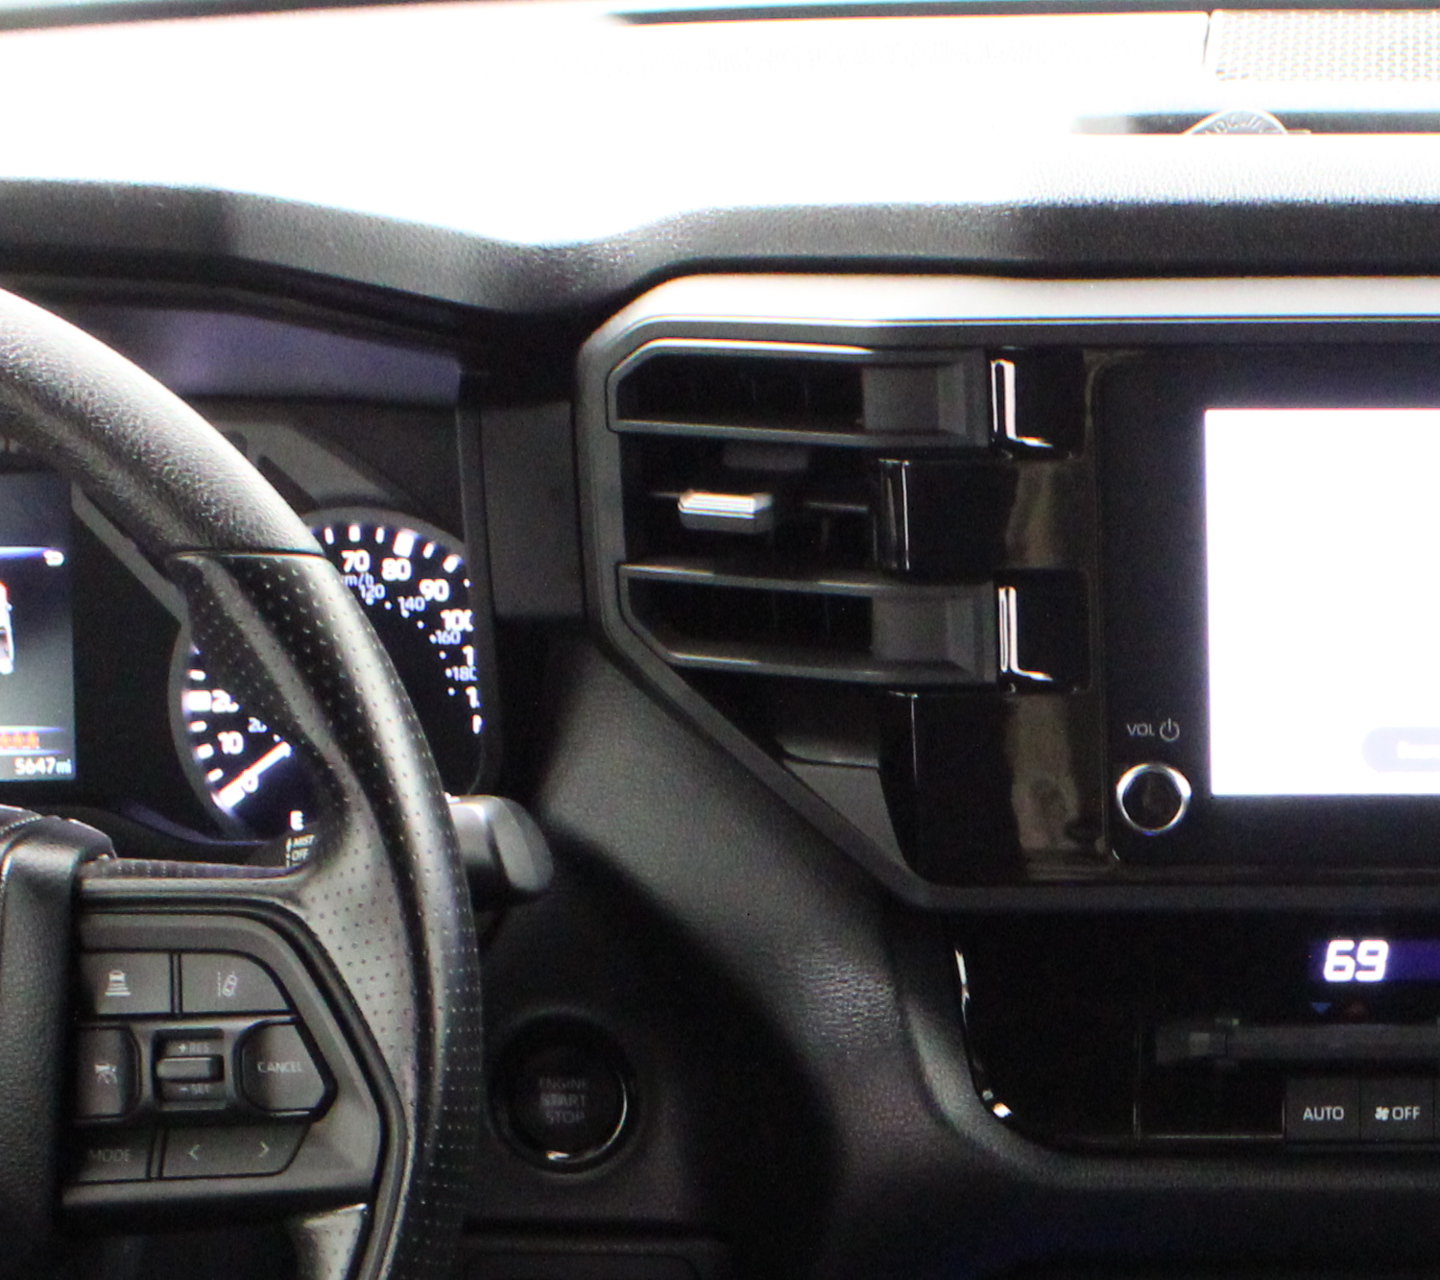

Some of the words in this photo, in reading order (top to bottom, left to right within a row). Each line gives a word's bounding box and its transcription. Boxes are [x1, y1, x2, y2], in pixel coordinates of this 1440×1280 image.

[341, 550, 371, 572] 70
[381, 557, 411, 581] 80
[341, 573, 375, 588] m/h
[358, 584, 386, 599] 120
[418, 578, 450, 602] 90
[397, 597, 426, 612] 140
[434, 630, 461, 645] 160
[210, 689, 240, 713] 2
[1126, 722, 1156, 738] VOL
[217, 731, 244, 755] 10
[289, 809, 305, 831] E
[1323, 939, 1390, 983] 69
[256, 1060, 303, 1074] CANCEL
[540, 1093, 588, 1107] START
[544, 1110, 586, 1125] STOP
[1302, 1106, 1345, 1121] AUTO
[1392, 1106, 1421, 1121] OFF
